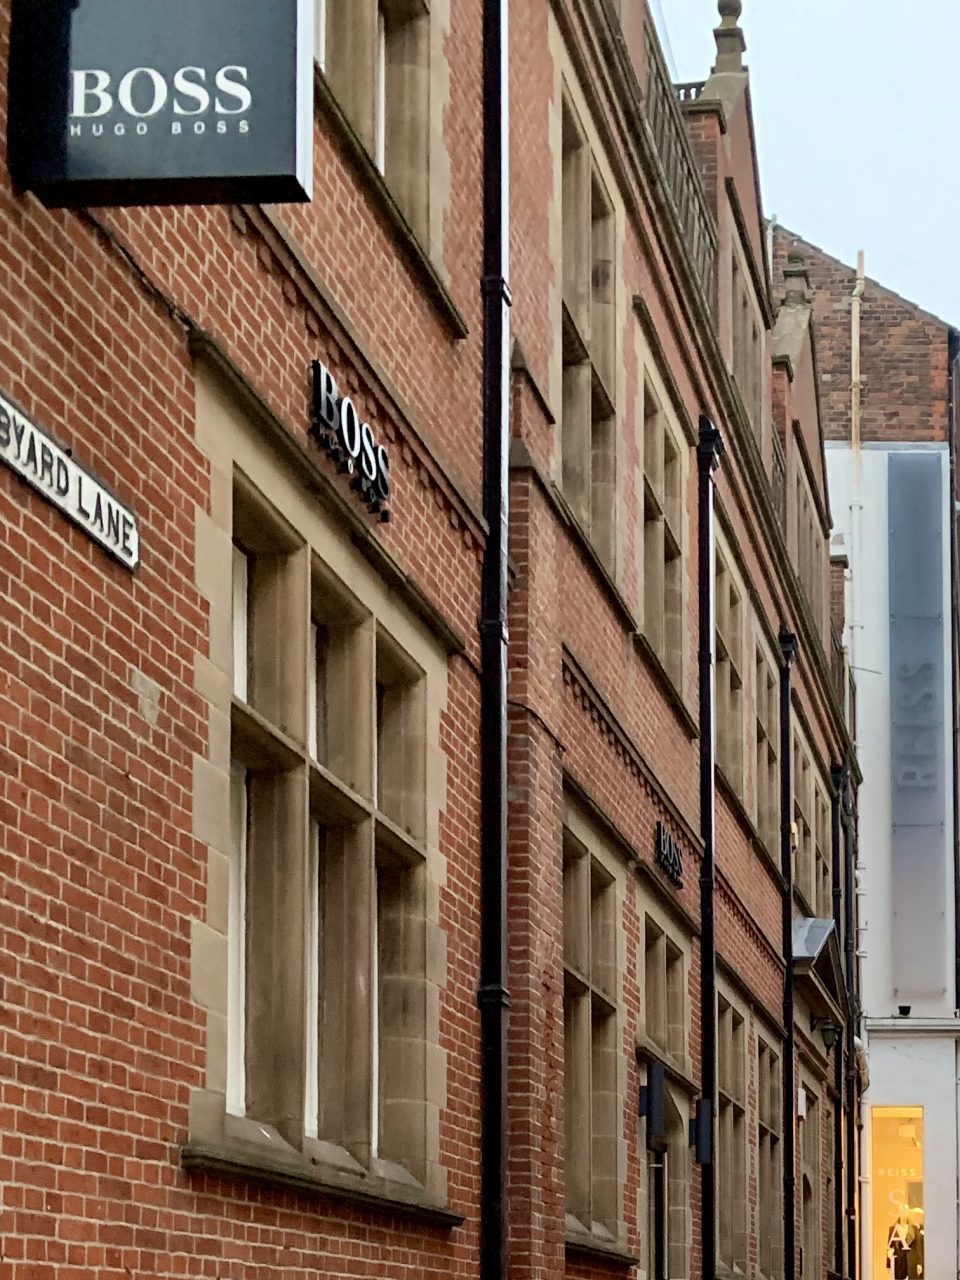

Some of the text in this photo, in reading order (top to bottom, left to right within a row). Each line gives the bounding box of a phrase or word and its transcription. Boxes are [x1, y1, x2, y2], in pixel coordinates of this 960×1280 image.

[68, 64, 253, 118] BOSS
[70, 120, 250, 137] HUGO BOSS
[313, 360, 390, 499] BOSS
[0, 405, 134, 557] BYARD LANE
[878, 1168, 917, 1177] REISS
